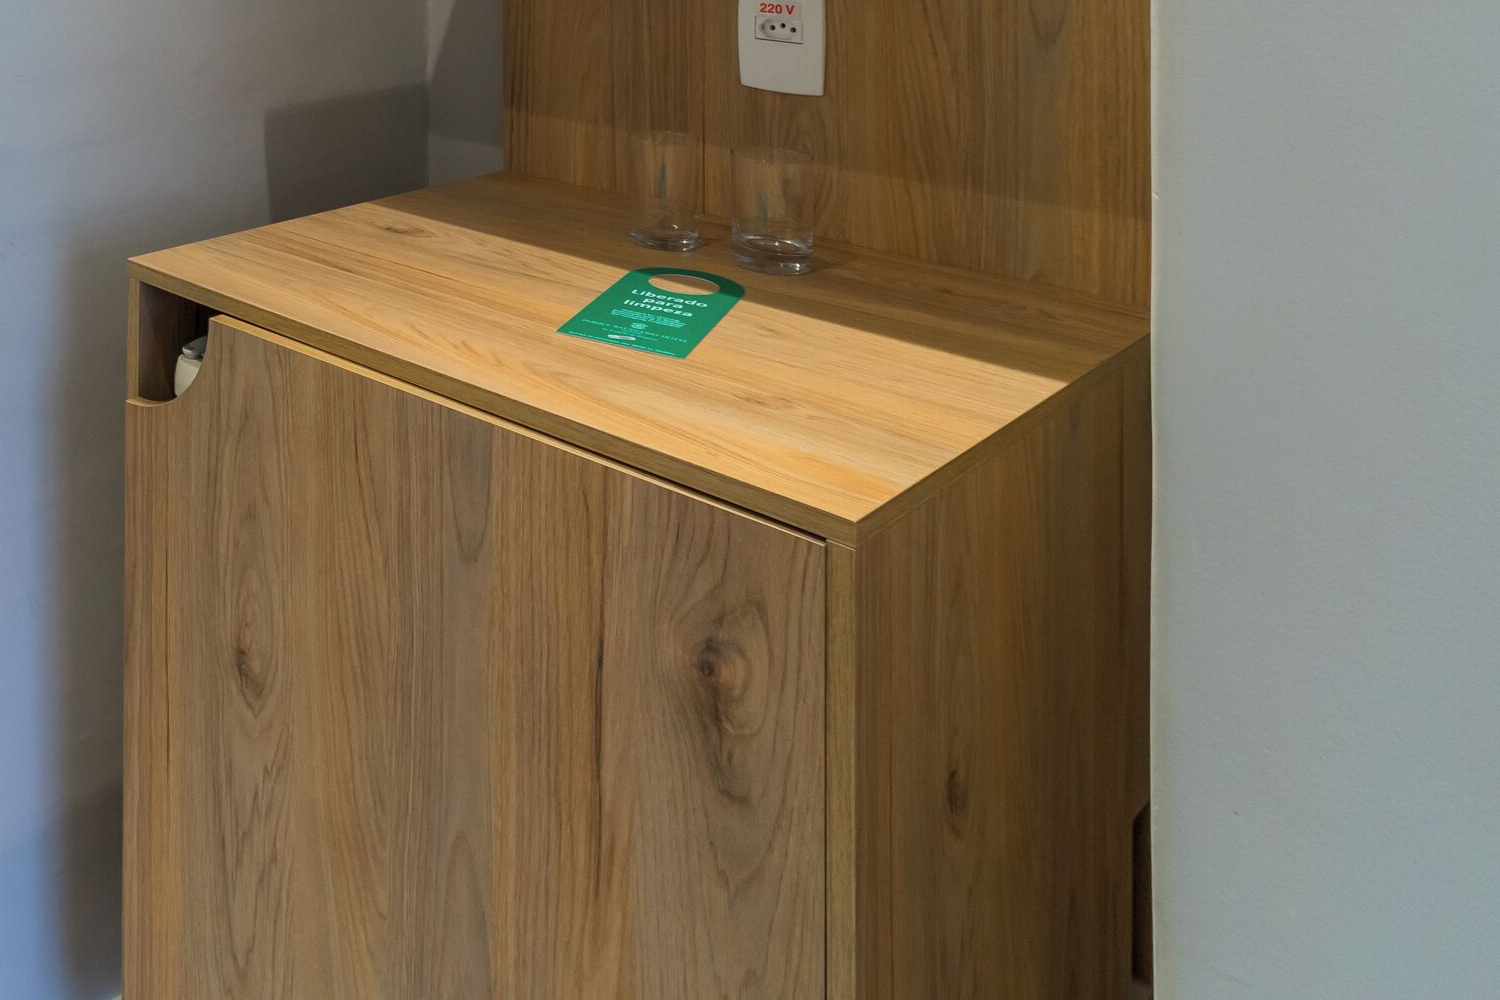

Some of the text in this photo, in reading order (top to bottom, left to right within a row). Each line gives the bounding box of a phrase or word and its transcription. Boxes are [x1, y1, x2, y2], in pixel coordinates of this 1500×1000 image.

[760, 2, 795, 15] 220 V
[631, 289, 708, 308] Liberado
[643, 298, 683, 309] para
[623, 299, 693, 317] limpeza
